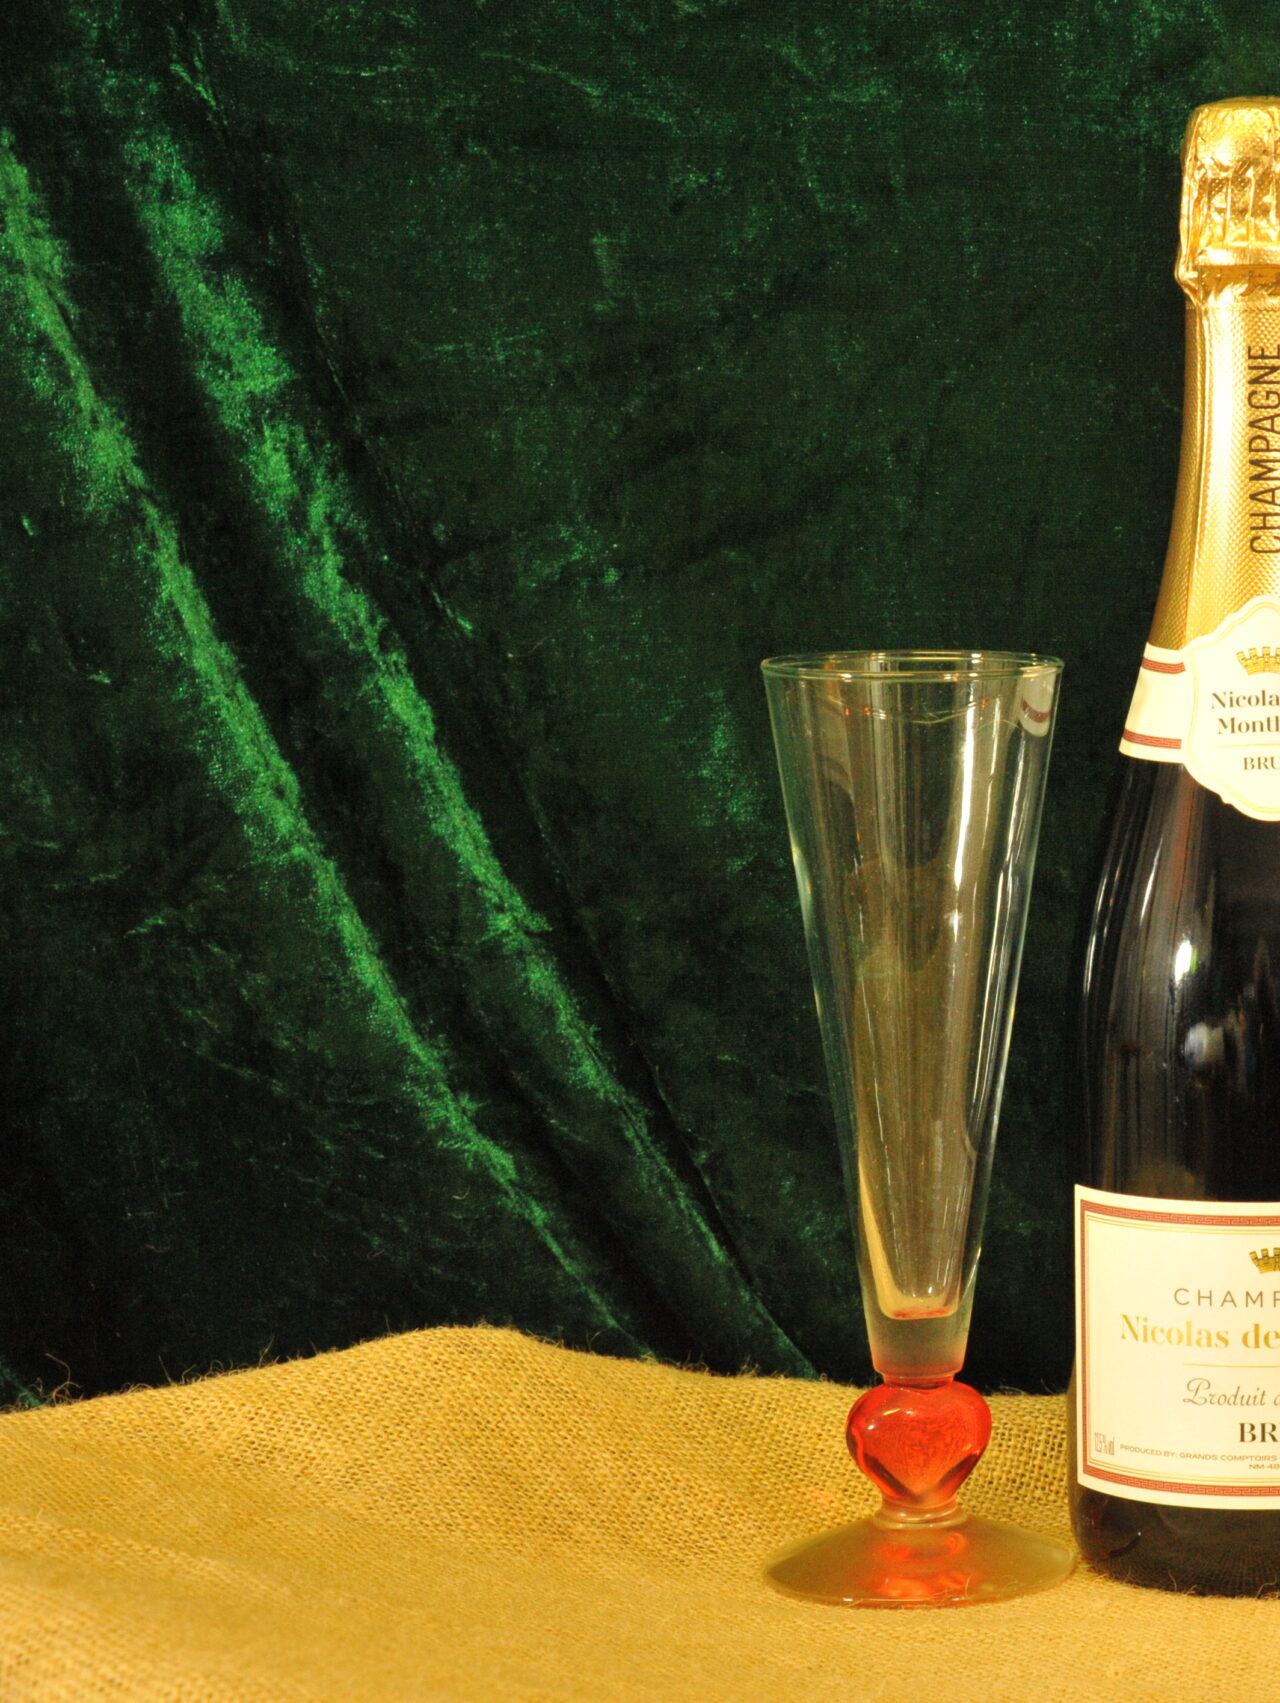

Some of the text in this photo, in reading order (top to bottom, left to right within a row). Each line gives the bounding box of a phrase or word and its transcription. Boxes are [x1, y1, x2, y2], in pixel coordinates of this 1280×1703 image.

[1120, 1313, 1230, 1349] Nicolas
[1241, 1323, 1280, 1350] de
[1182, 1377, 1266, 1406] Produit
[1119, 1443, 1162, 1456] PRODUCED
[1179, 1452, 1218, 1461] GRANDS
[1220, 1454, 1278, 1462] COMPTOIRS
